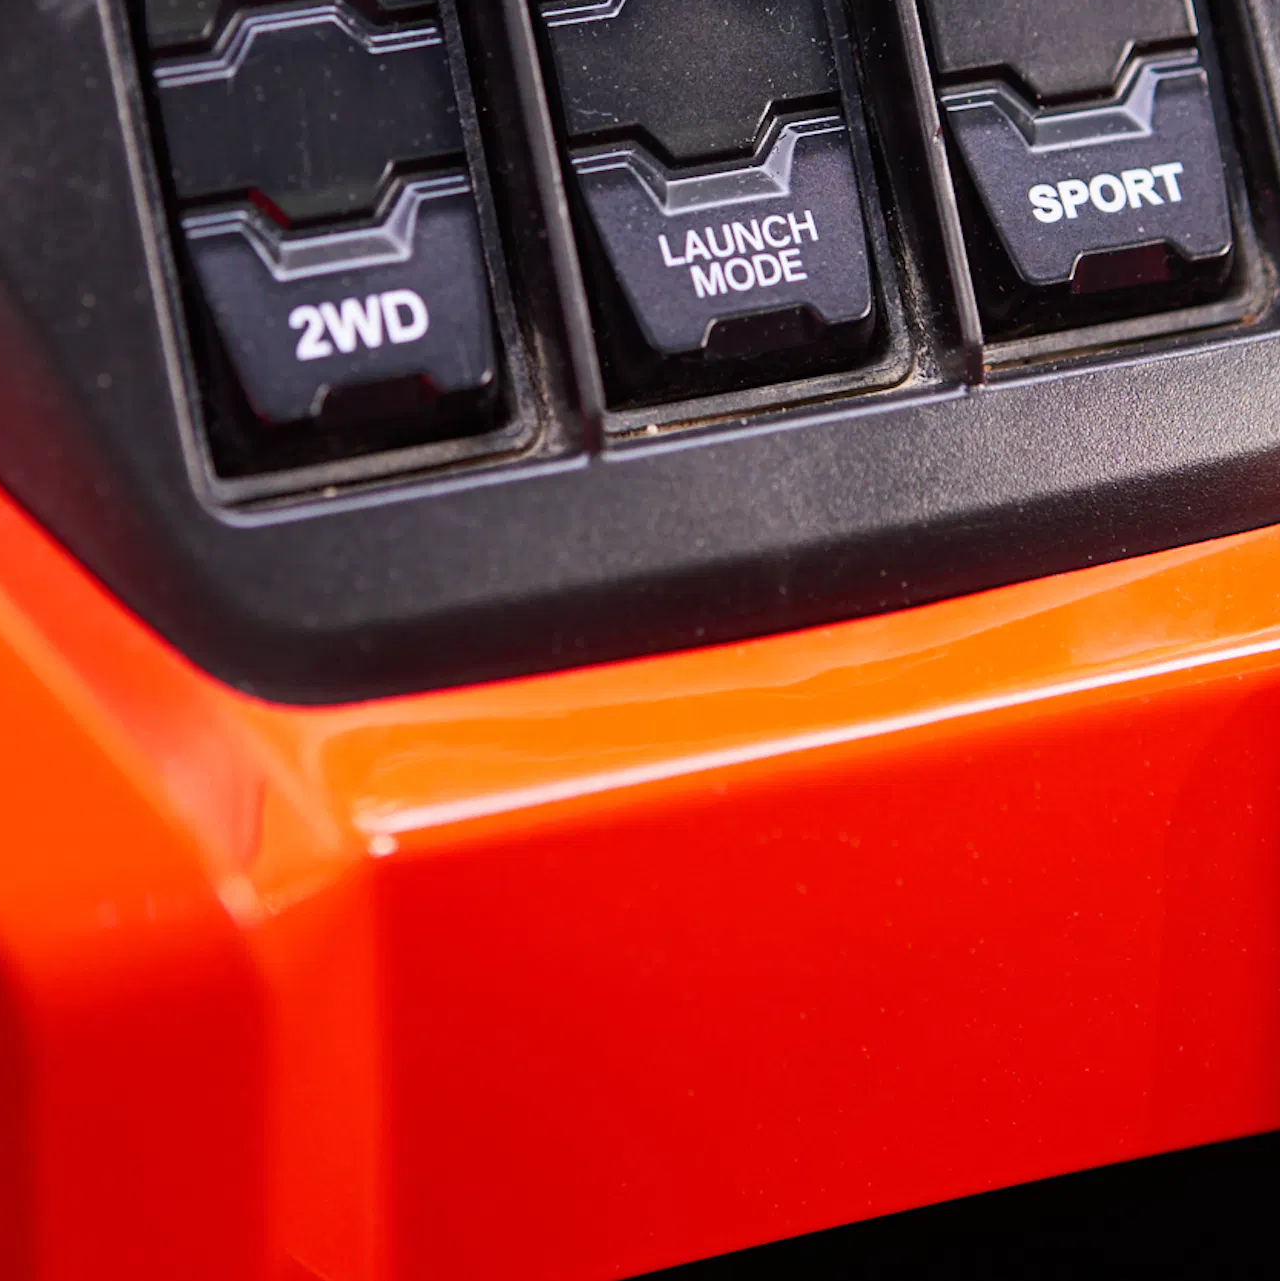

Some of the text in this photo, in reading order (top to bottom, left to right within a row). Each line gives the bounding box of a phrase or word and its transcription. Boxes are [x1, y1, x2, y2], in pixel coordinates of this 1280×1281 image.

[1028, 161, 1184, 224] SPORT
[657, 209, 820, 268] LAUNCH
[689, 247, 809, 299] MODE
[288, 289, 430, 361] 2WD
